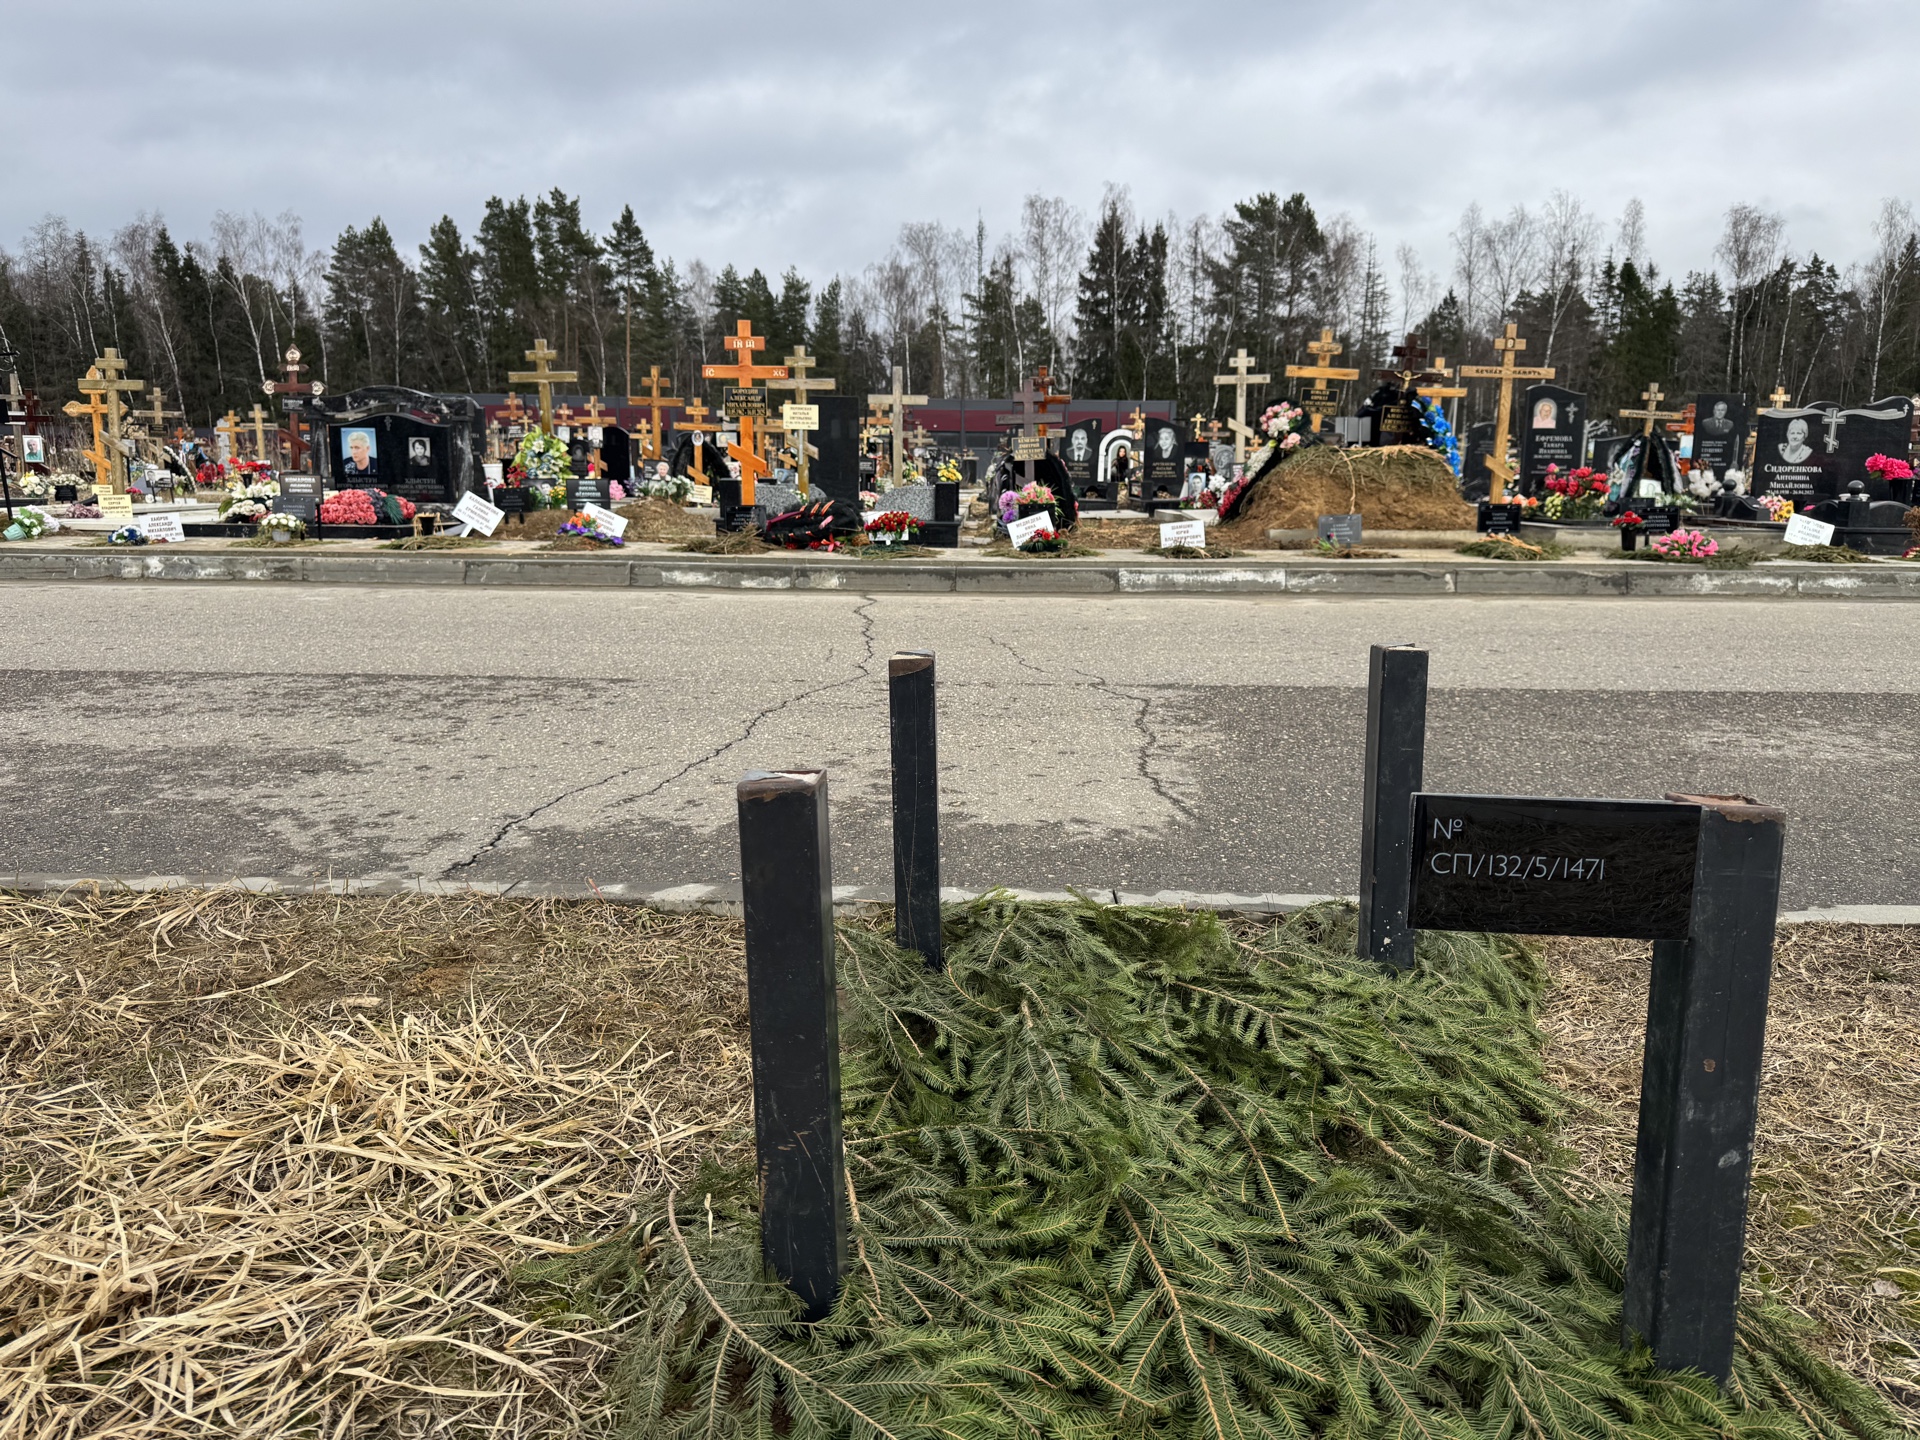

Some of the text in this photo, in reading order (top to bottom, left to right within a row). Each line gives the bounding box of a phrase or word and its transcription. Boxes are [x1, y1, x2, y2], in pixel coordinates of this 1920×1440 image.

[1764, 463, 1823, 473] СИДОРЕНКОВА
[1774, 473, 1810, 481] АНТОНИНА
[1769, 481, 1814, 489] МИХАЙЛОВНА
[469, 495, 500, 516] КАЛАШНИКОВА
[473, 504, 489, 516] ГАЛИНА
[1015, 516, 1042, 528] МЕДВЕДЕВА
[1164, 534, 1202, 542] ВЛАДИМИРОВИЧ
[1433, 818, 1463, 840] №
[1431, 853, 1606, 880] СП/132/5/1471
